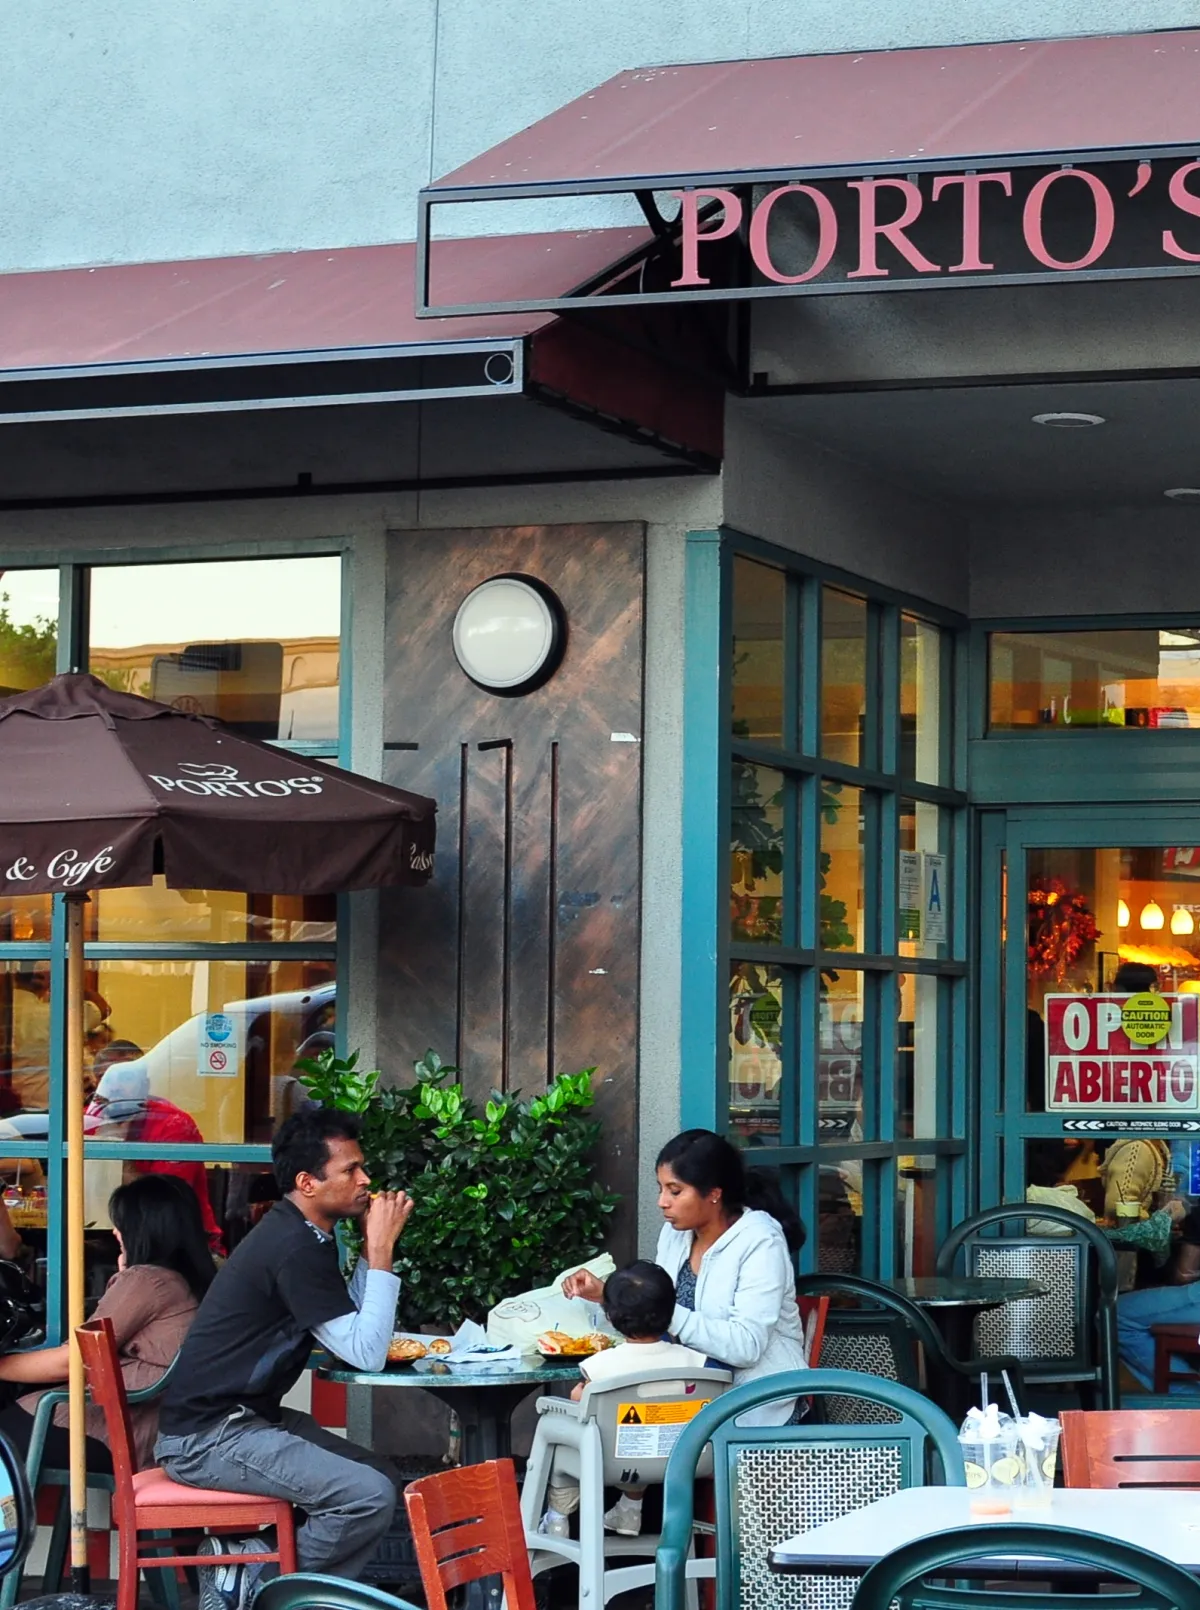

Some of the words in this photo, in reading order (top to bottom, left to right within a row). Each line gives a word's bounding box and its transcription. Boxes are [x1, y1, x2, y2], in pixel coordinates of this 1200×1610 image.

[5, 857, 38, 881] &
[929, 869, 941, 911] A
[1063, 1001, 1183, 1050] OPN
[1122, 1011, 1169, 1021] CAUTION
[1053, 1059, 1194, 1103] ABIERTO
